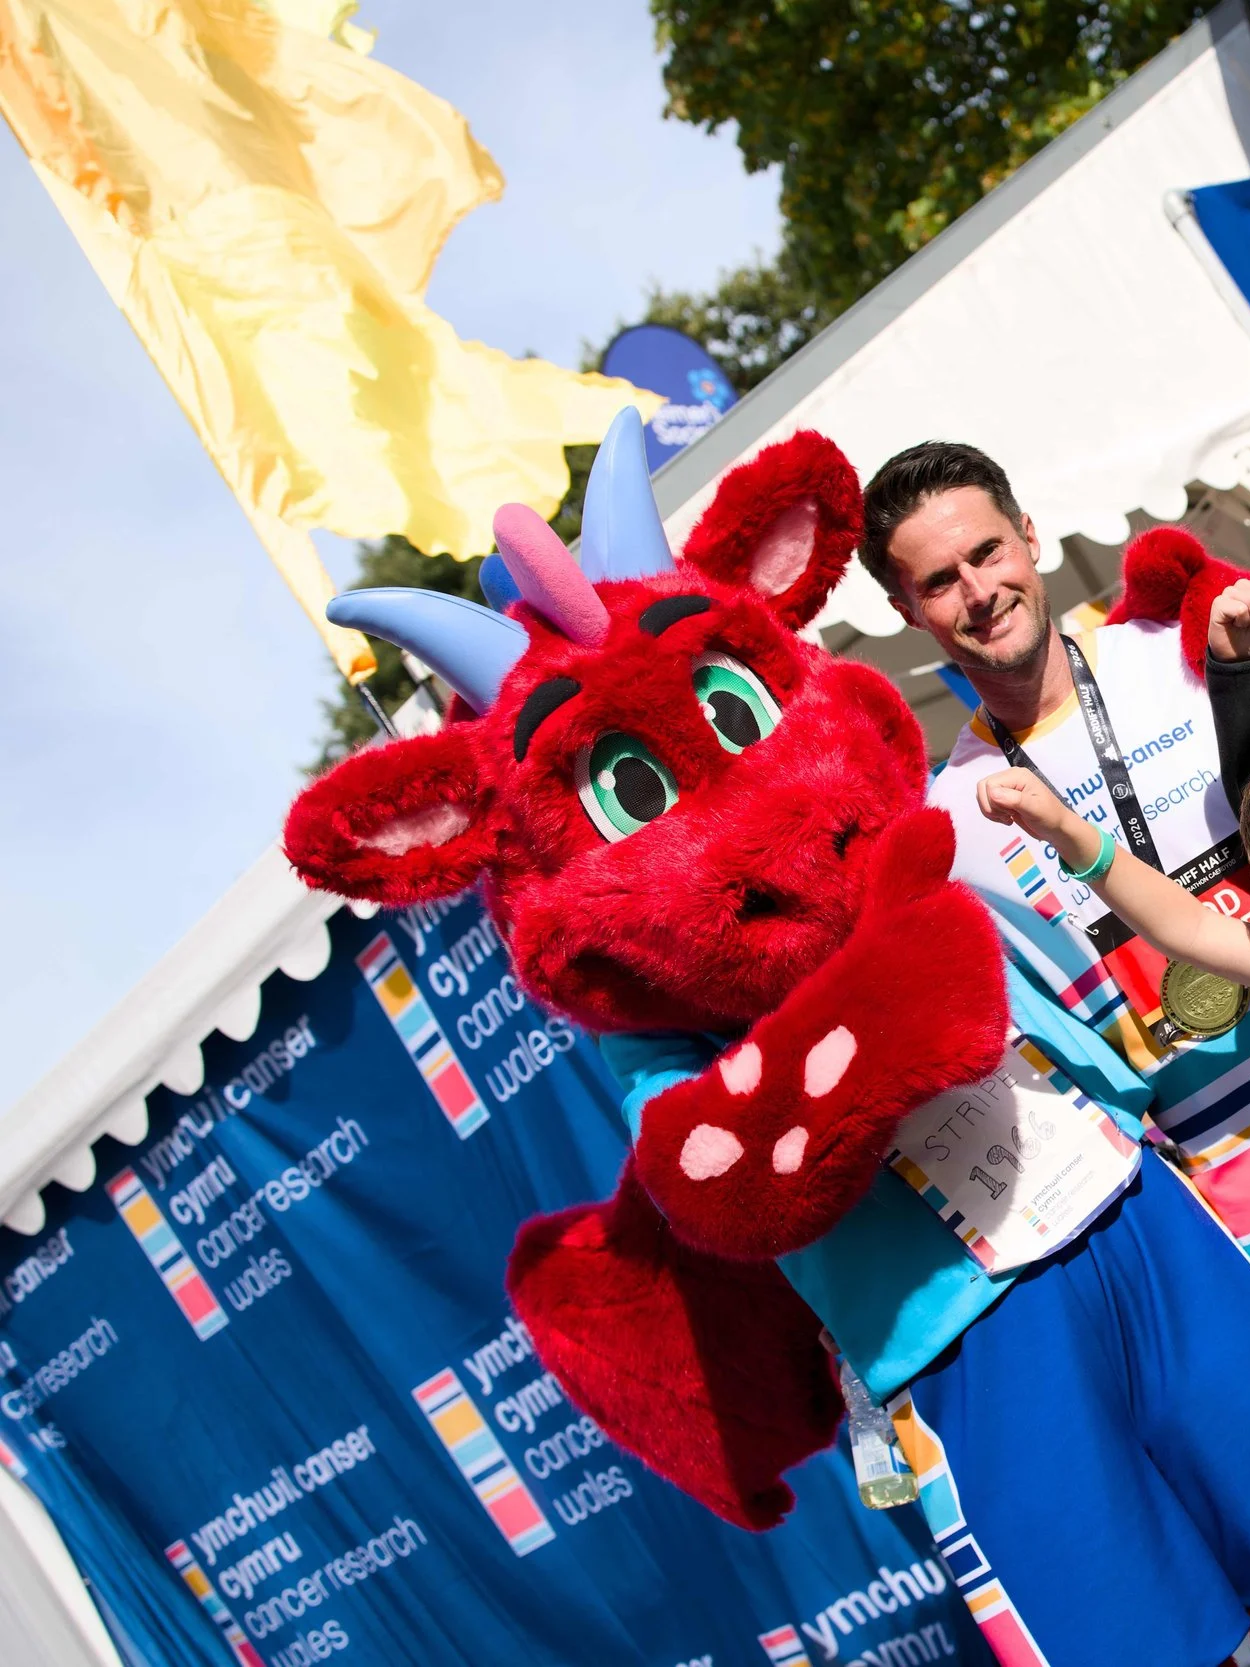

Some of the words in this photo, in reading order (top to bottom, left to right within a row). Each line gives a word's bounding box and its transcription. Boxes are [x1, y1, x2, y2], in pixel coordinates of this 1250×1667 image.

[1068, 644, 1084, 668] 2026
[1079, 684, 1093, 708] HALF
[1086, 706, 1106, 745] CARDIFF
[1142, 769, 1219, 822] search
[1127, 817, 1147, 846] 2026
[1199, 847, 1231, 874] HALF
[456, 974, 525, 1050] canc
[223, 1013, 316, 1110] canser
[485, 1016, 576, 1103] wales
[924, 1066, 1019, 1163] STRIPE
[168, 1154, 237, 1226] cymru
[968, 1110, 1057, 1201] 1966
[1030, 1173, 1064, 1206] ymchwil
[1061, 1153, 1085, 1177] canser
[196, 1193, 267, 1269] cancer
[257, 1114, 370, 1213] research
[1037, 1187, 1062, 1213] cymru
[4, 1226, 74, 1302] canser
[223, 1247, 293, 1312] wales
[34, 1315, 120, 1398] research
[523, 1414, 609, 1480] cance
[190, 1464, 303, 1567] ymchwil
[292, 1423, 377, 1493] canser
[552, 1465, 634, 1526] wales
[217, 1530, 303, 1600] cymru
[243, 1568, 330, 1640] cancer
[324, 1514, 429, 1592] research
